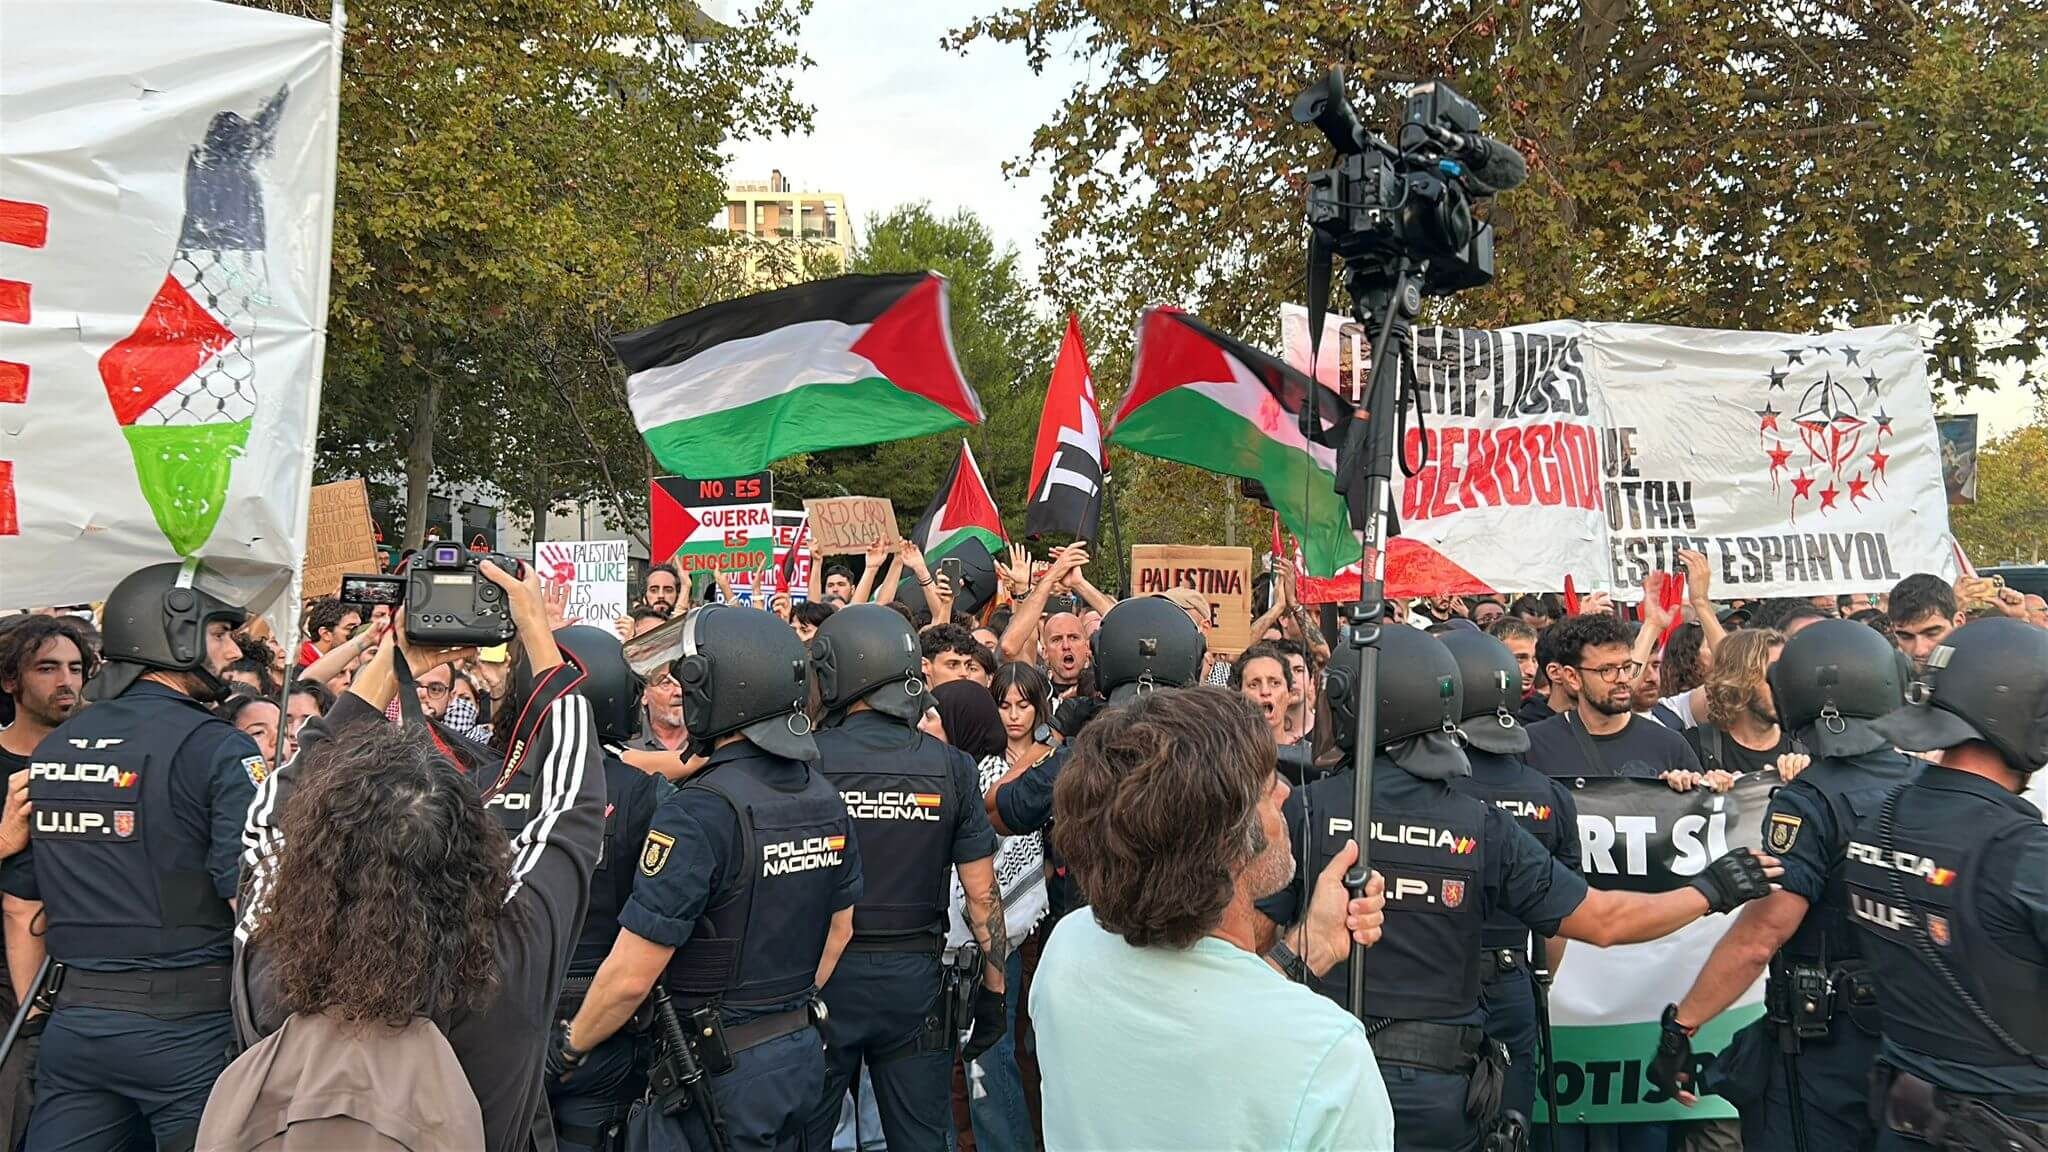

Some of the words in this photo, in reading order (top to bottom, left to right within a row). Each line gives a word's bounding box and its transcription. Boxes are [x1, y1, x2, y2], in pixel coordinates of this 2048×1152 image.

[1601, 426, 1641, 478] UE
[700, 480, 724, 499] NO
[735, 479, 761, 498] ES
[702, 507, 770, 528] GUERRA
[815, 501, 850, 527] RED
[1604, 480, 1697, 532] OTAN
[724, 529, 749, 548] ES
[573, 543, 626, 563] PALESTINA
[682, 551, 766, 571] ENOCIDIO
[1716, 533, 1901, 585] ESPANYOL
[1141, 567, 1242, 595] PALESTINA
[30, 762, 120, 783] POLICIA
[496, 739, 525, 789] Canon
[37, 811, 111, 834] U.I.P.
[847, 805, 940, 821] ACIONAL
[1328, 818, 1457, 849] PLICIA
[1577, 815, 1657, 876] RT
[763, 837, 832, 861] POLICIA
[763, 851, 843, 878] NACIONAL
